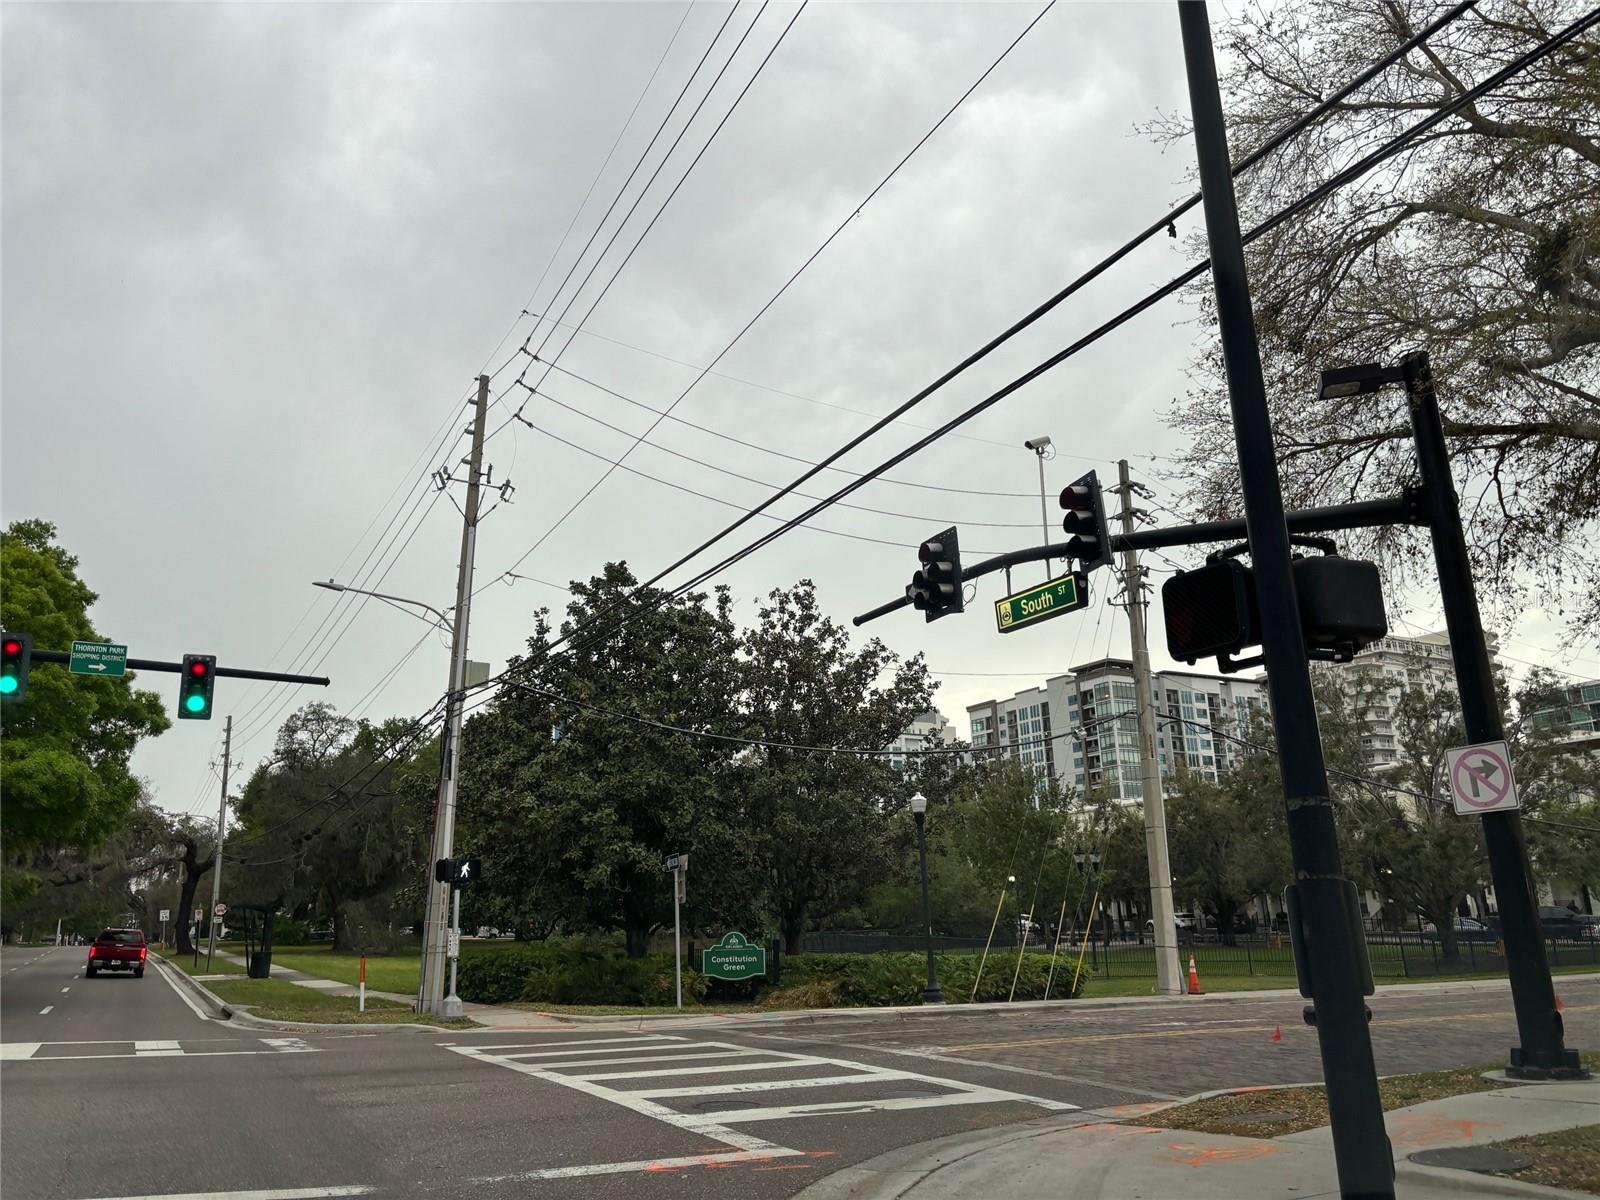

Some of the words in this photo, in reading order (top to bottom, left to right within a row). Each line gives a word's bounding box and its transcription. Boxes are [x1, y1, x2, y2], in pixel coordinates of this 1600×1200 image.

[1021, 592, 1053, 615] South
[1057, 585, 1066, 595] ST
[75, 644, 107, 653] THORNTON
[110, 647, 125, 655] PARK
[72, 652, 100, 660] SHOPPING
[102, 654, 125, 662] DISTRICT
[711, 955, 757, 963] Constitution
